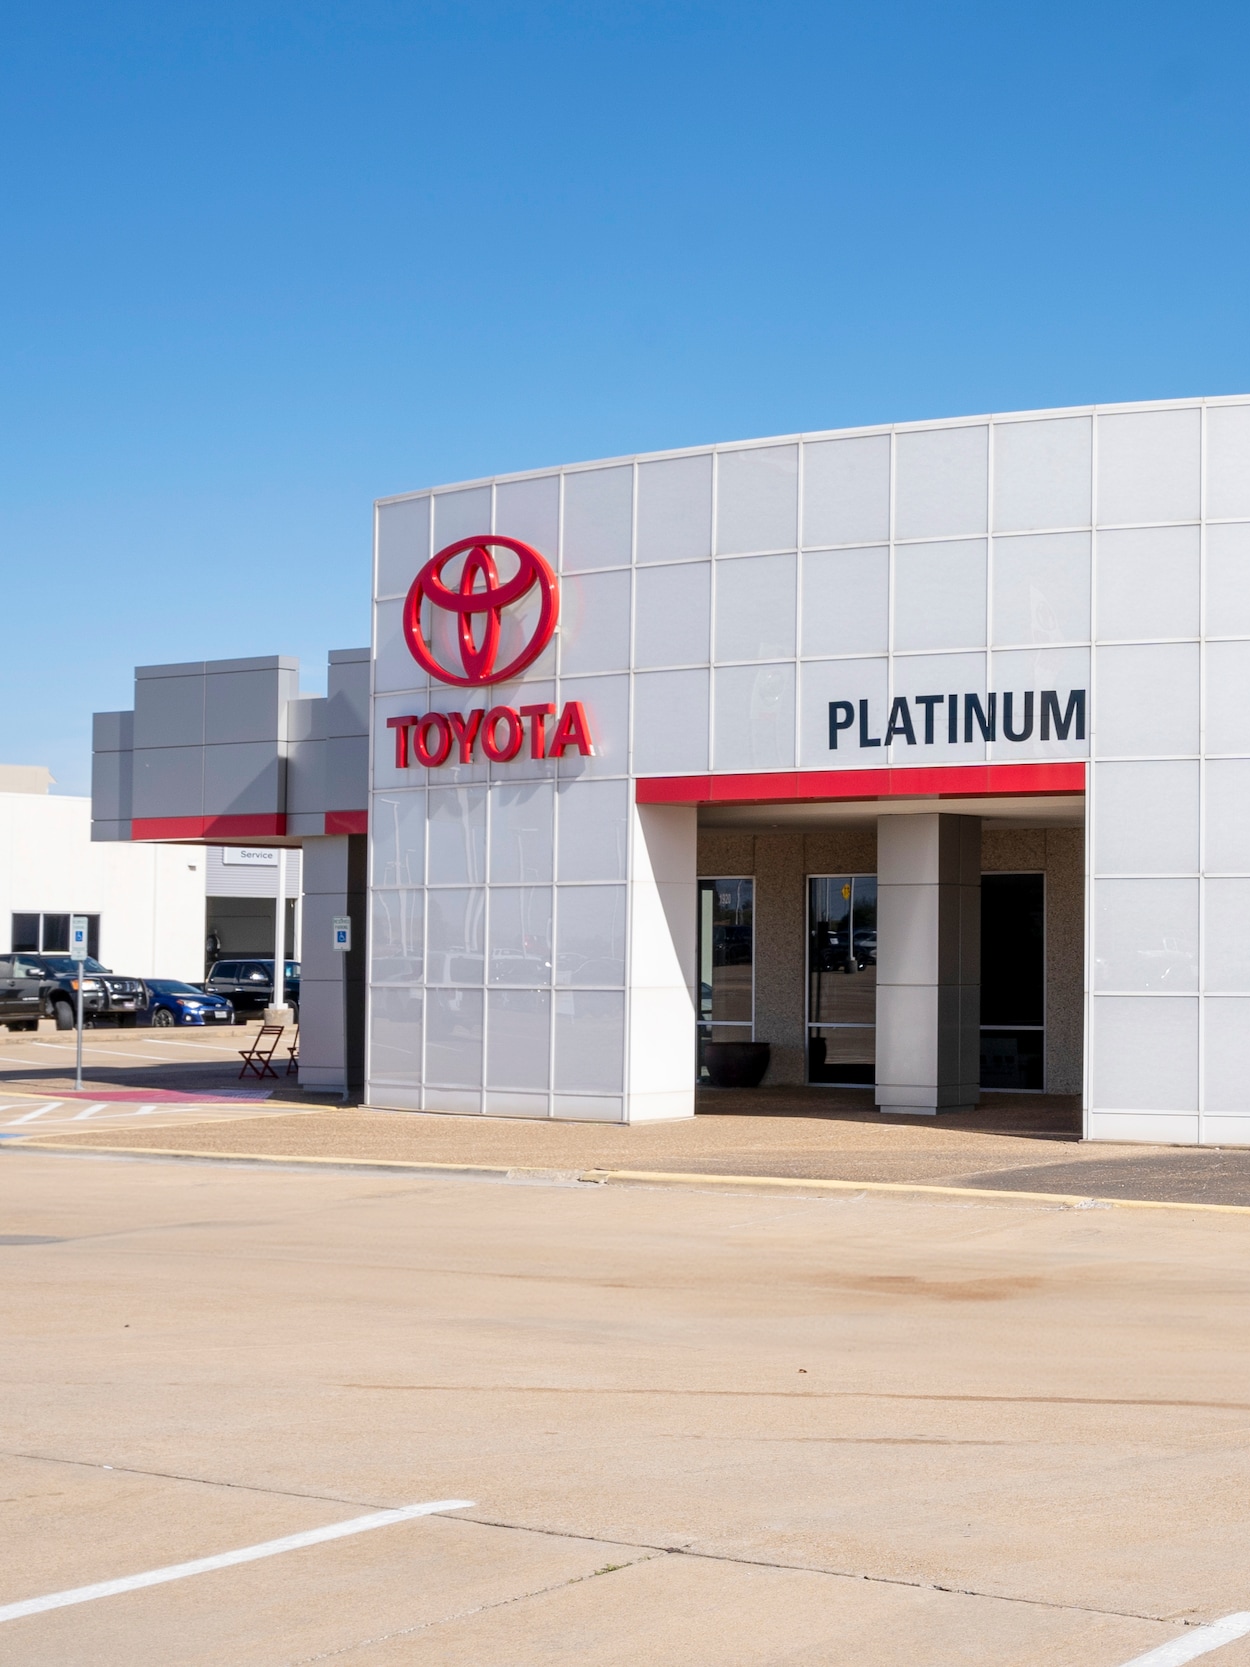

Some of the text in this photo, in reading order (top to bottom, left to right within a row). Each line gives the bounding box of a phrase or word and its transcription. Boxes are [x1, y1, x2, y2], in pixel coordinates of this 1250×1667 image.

[386, 700, 595, 768] TOYOTA
[828, 689, 1086, 750] PLATINUM
[240, 850, 273, 859] Service
